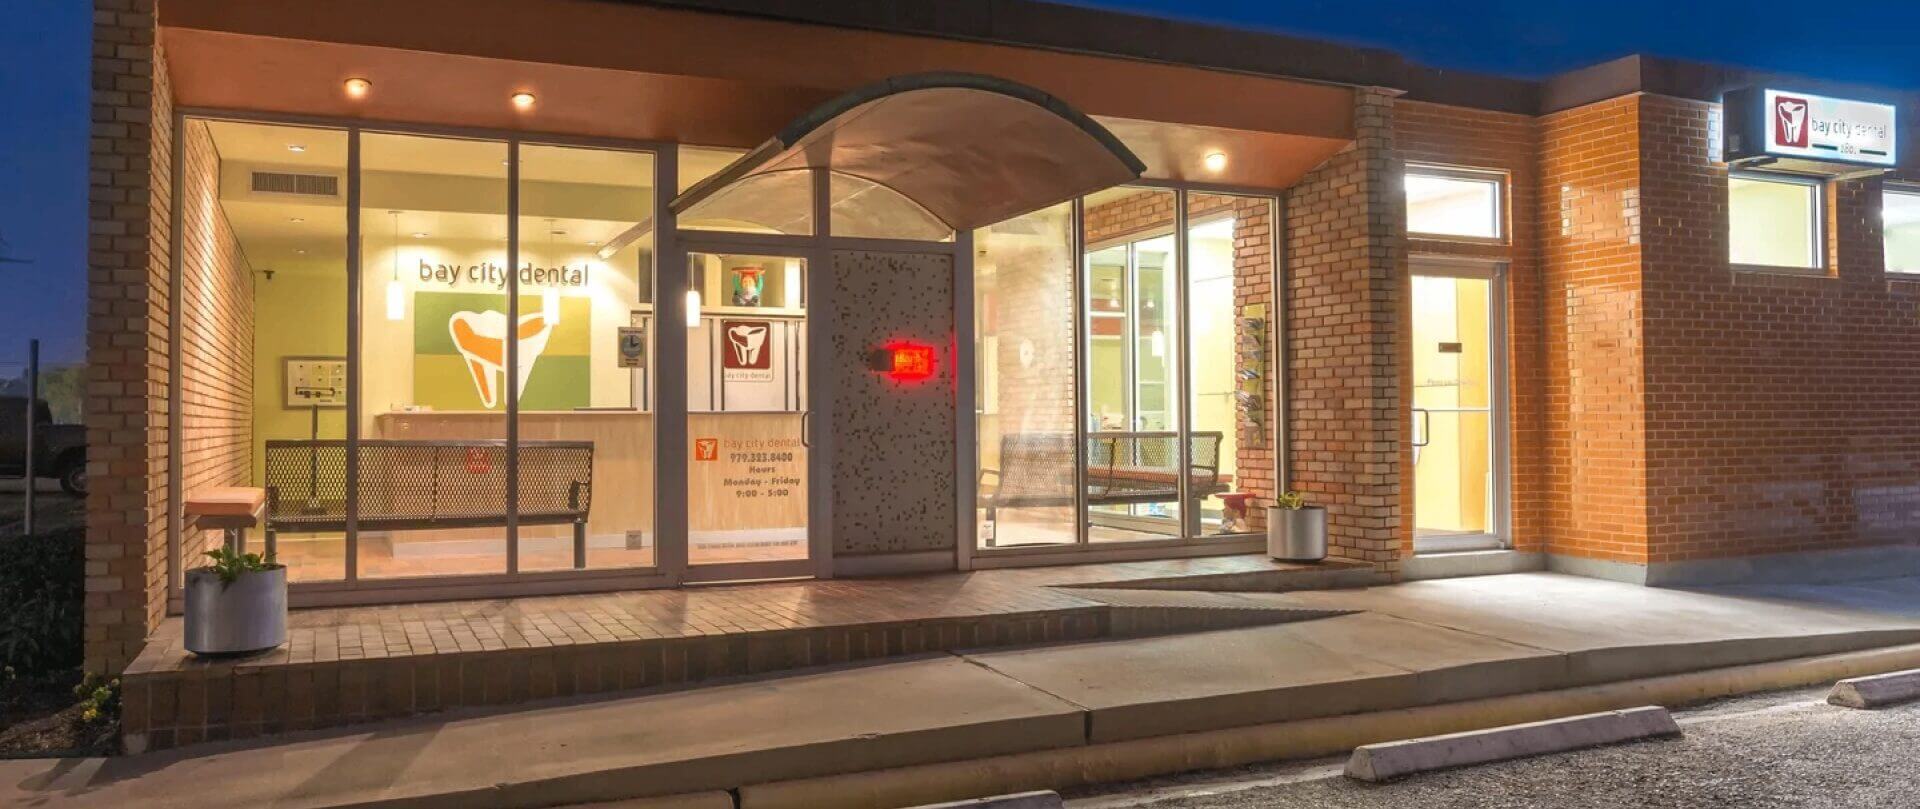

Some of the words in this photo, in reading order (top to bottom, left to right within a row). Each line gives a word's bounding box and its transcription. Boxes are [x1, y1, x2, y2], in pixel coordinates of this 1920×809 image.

[1811, 117, 1830, 136] bay
[1833, 118, 1851, 138] city
[1855, 122, 1886, 140] dental
[419, 258, 461, 286] bay
[469, 262, 508, 290] city
[520, 262, 589, 287] dental
[724, 439, 743, 450] bay
[745, 439, 765, 449] city
[768, 437, 800, 448] dental
[749, 465, 776, 474] Hours
[723, 477, 762, 487] Monday
[771, 476, 801, 486] Friday
[736, 489, 758, 498] 9:00
[768, 488, 789, 497] 5:00
